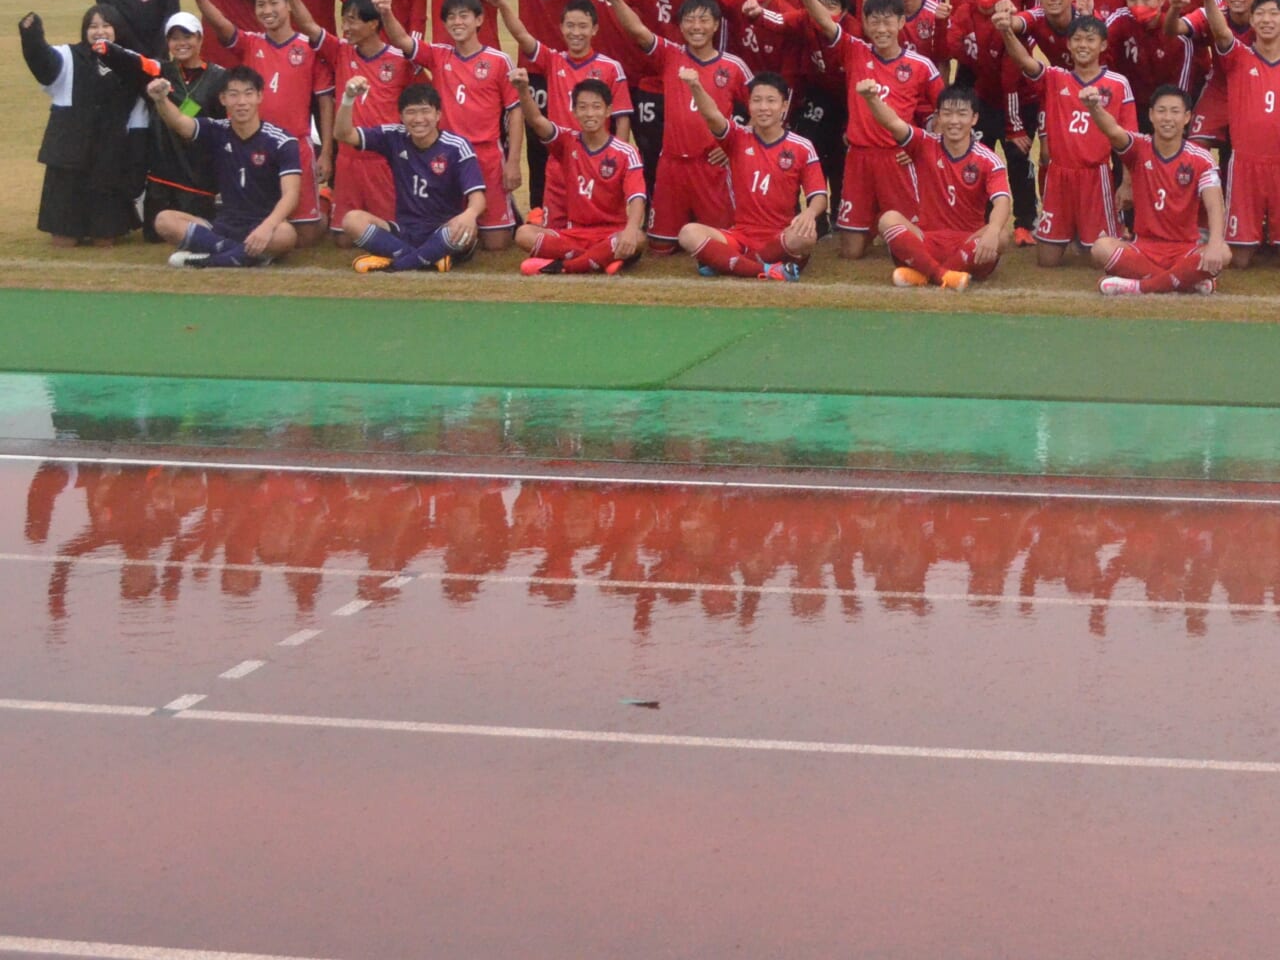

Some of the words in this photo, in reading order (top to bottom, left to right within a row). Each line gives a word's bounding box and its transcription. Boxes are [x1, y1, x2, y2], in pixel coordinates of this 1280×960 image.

[656, 2, 672, 24] 15
[270, 71, 280, 94] 4
[455, 84, 466, 105] 6
[1264, 90, 1277, 113] 9
[638, 102, 655, 123] 15
[1069, 109, 1090, 135] 25
[238, 167, 246, 188] 1
[412, 174, 429, 199] 12
[577, 175, 595, 200] 24
[751, 170, 771, 196] 14
[947, 185, 956, 207] 5
[1155, 188, 1166, 211] 3
[1229, 216, 1238, 238] 9
